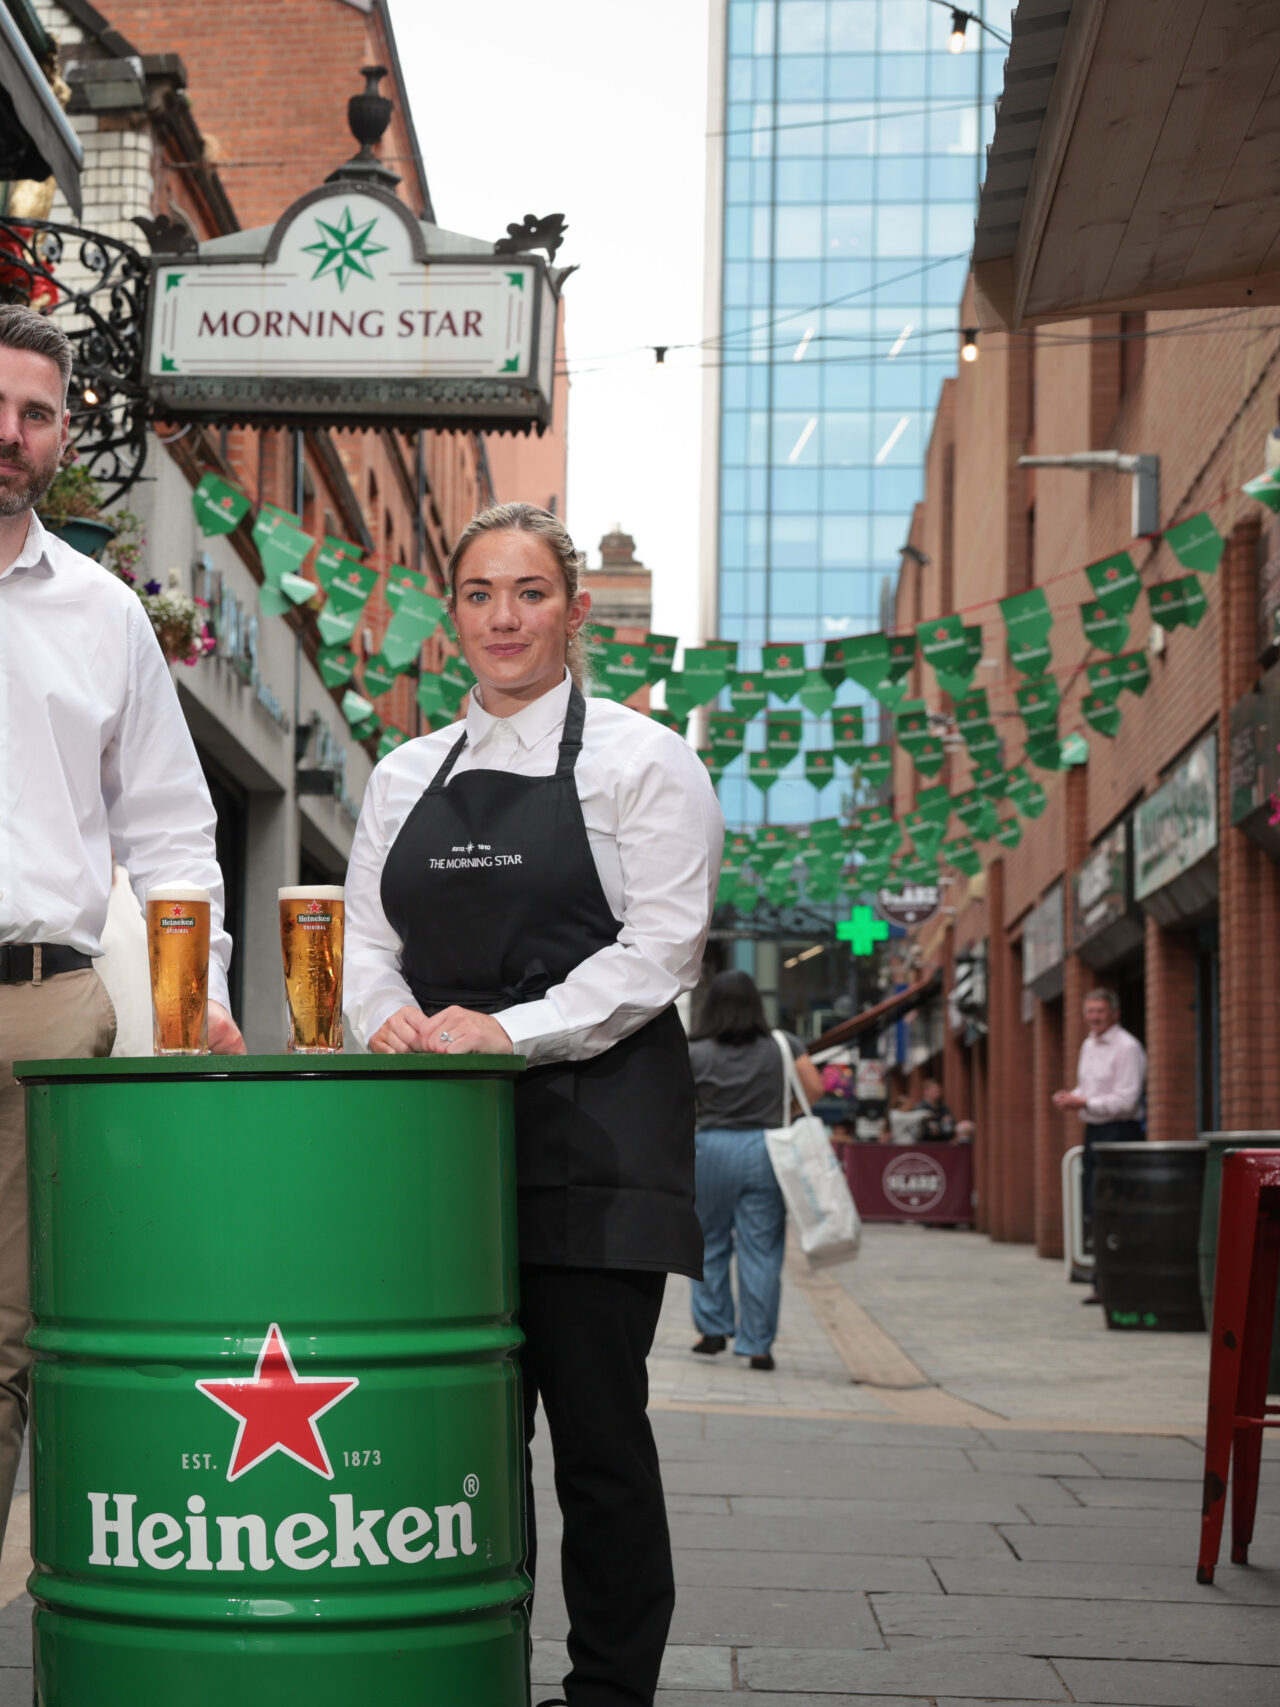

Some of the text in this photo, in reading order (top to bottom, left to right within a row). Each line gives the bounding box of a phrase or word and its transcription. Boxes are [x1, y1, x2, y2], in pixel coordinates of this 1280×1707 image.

[198, 310, 483, 338] MORNING STAR
[429, 854, 523, 869] THE MORNING STAR
[298, 915, 331, 923] Heineken
[181, 1450, 382, 1470] EST. 1873
[87, 1491, 477, 1571] Heineken
